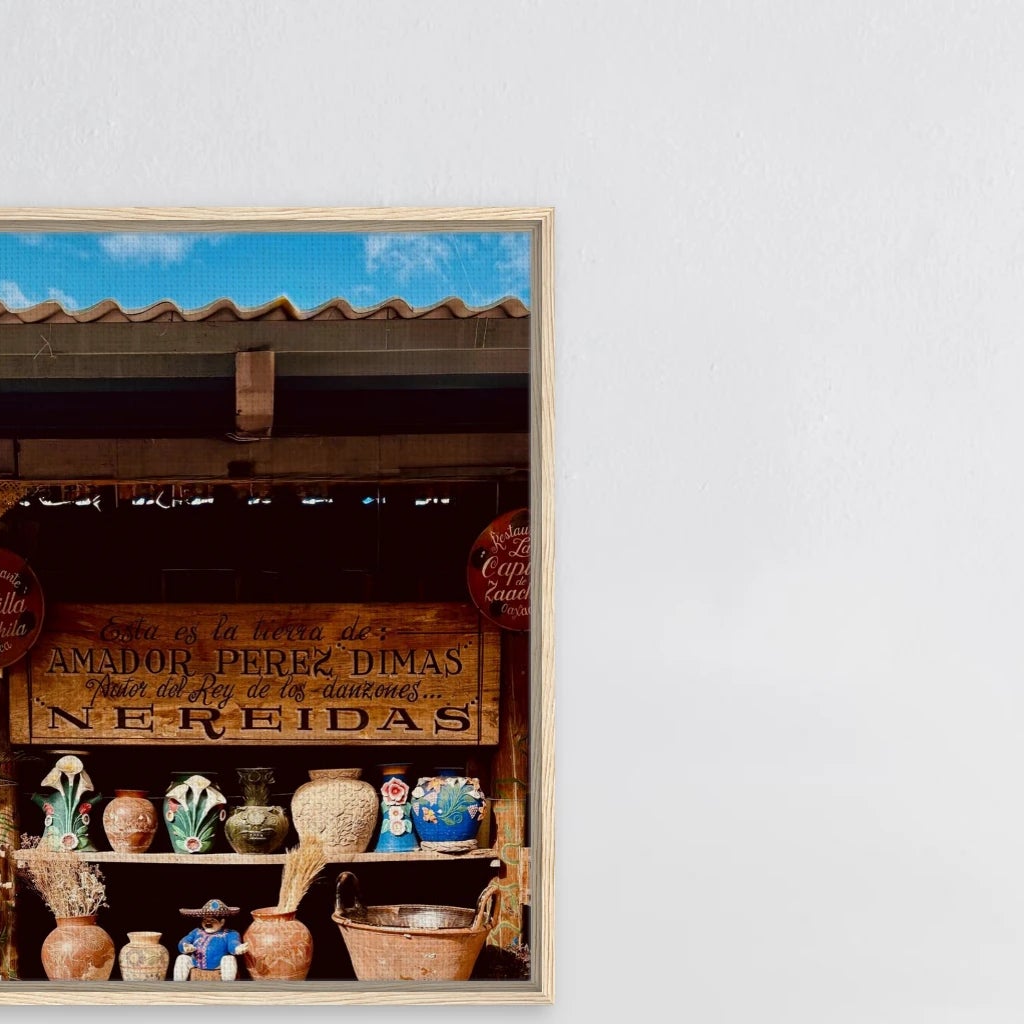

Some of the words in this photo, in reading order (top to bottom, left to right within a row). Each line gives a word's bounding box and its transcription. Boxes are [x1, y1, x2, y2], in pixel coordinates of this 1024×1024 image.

[489, 524, 531, 554] Restau
[99, 615, 158, 643] Esta
[174, 623, 198, 645] es
[212, 614, 239, 641] la
[252, 615, 324, 642] tierra
[45, 647, 195, 676] AMADOR
[214, 645, 334, 678] PEREZ
[85, 673, 148, 706] Autor
[156, 674, 188, 699] del
[188, 673, 234, 710] Rey
[246, 676, 271, 699] de
[279, 676, 307, 702] los
